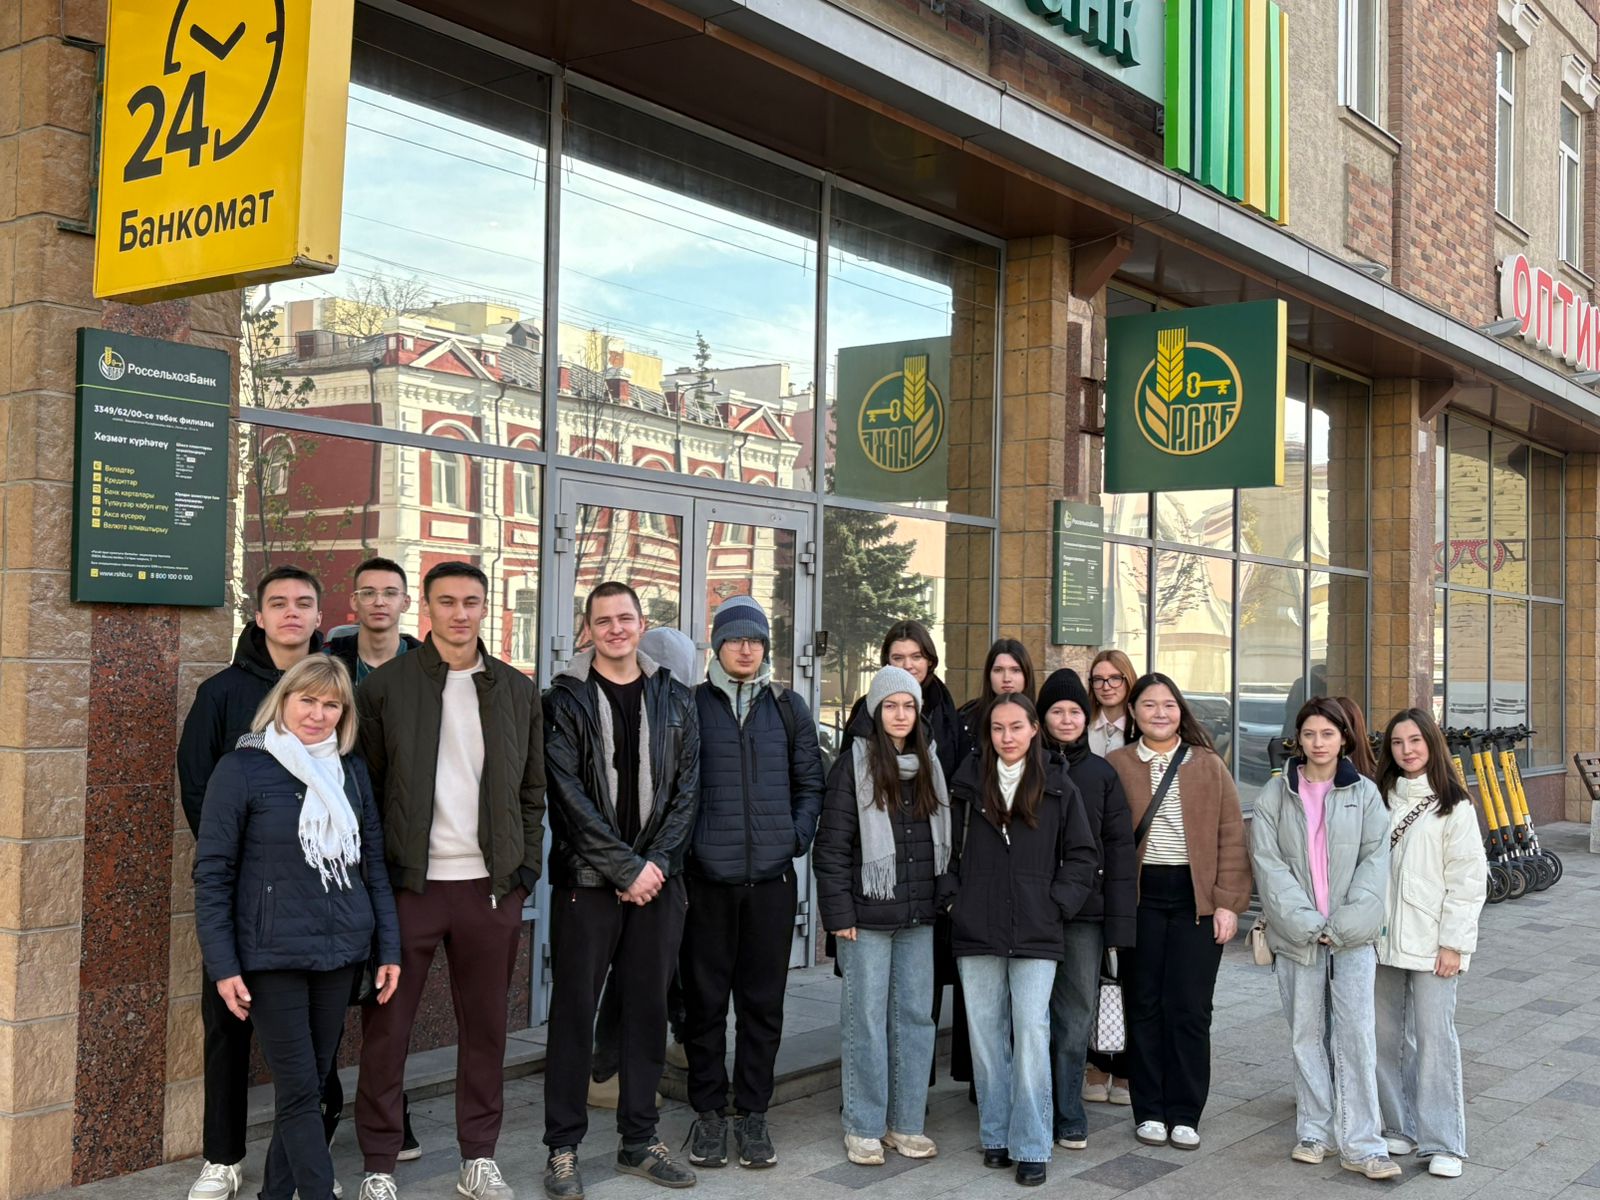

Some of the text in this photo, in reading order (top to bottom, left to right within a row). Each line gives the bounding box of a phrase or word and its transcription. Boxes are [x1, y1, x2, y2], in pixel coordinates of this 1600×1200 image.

[122, 70, 209, 183] 24
[119, 189, 275, 253] Банкомат
[127, 362, 217, 387] РоссельхозБанк
[179, 416, 215, 428] филиалы
